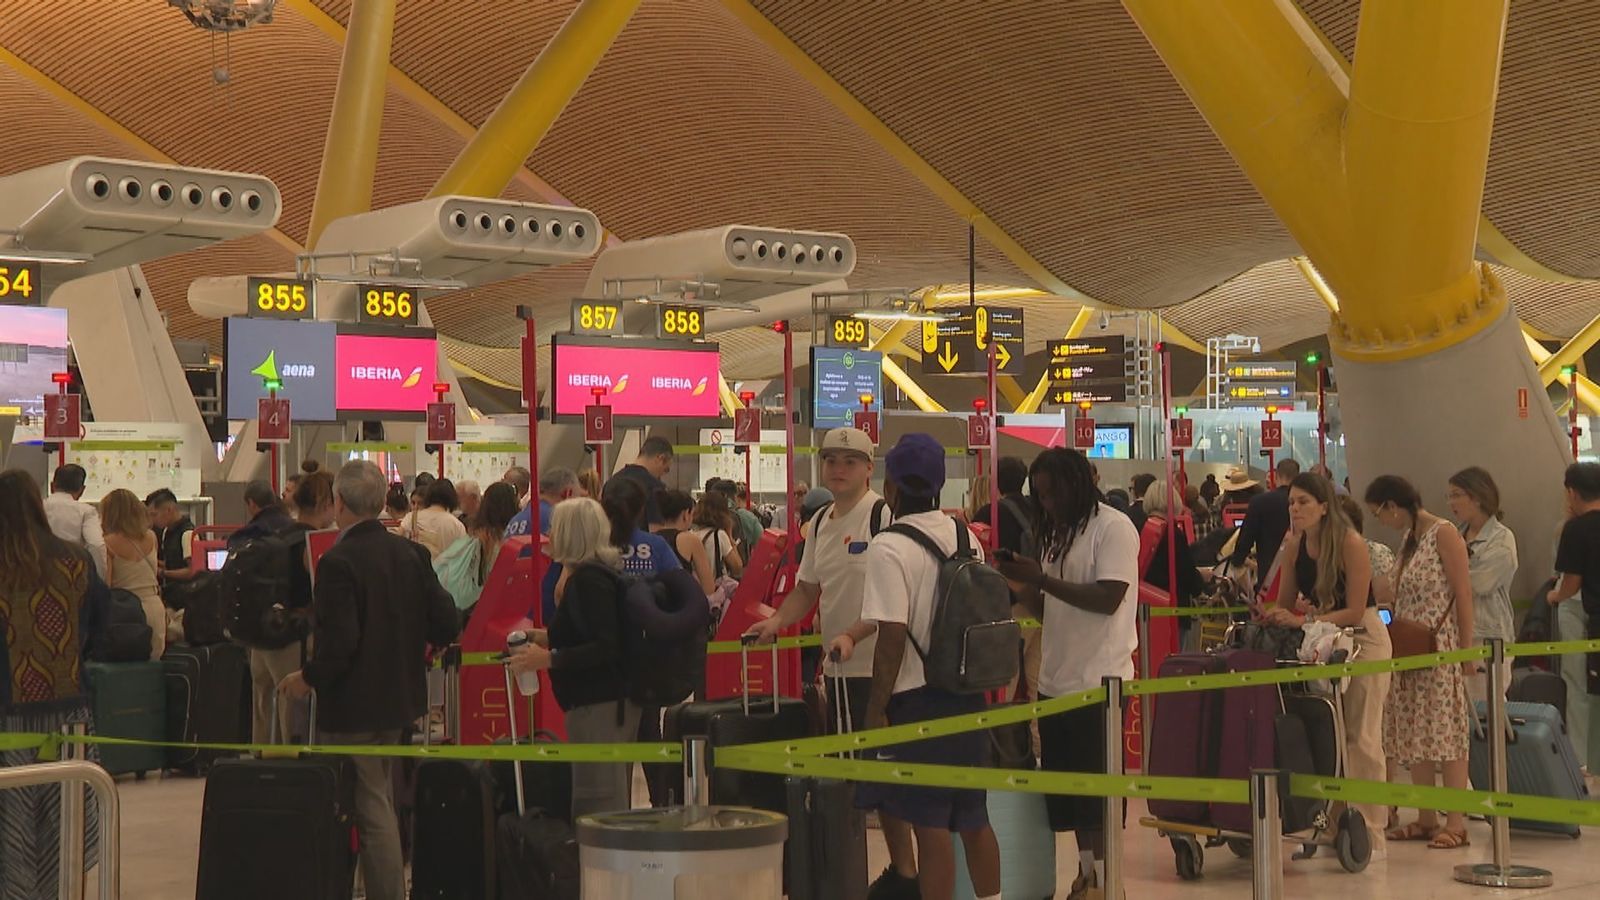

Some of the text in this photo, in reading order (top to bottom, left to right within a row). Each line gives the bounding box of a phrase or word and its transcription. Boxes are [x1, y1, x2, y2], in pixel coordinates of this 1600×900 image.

[258, 283, 306, 311] 855
[366, 290, 412, 317] 856
[580, 304, 617, 329] 857
[664, 310, 700, 334] 858
[834, 319, 865, 342] 859
[282, 364, 315, 377] aena
[351, 366, 402, 380] IBERIA
[568, 373, 612, 387] IBERIA
[652, 376, 692, 389] IBERIA
[56, 408, 68, 424] 3
[269, 412, 280, 426] 4
[438, 415, 447, 429] 5
[594, 416, 604, 430] 6
[862, 421, 871, 433] 8
[975, 424, 984, 436] 9
[1077, 427, 1093, 439] 10
[1176, 427, 1188, 438] 11
[1264, 428, 1280, 440] 12
[1095, 431, 1128, 441] ANGO
